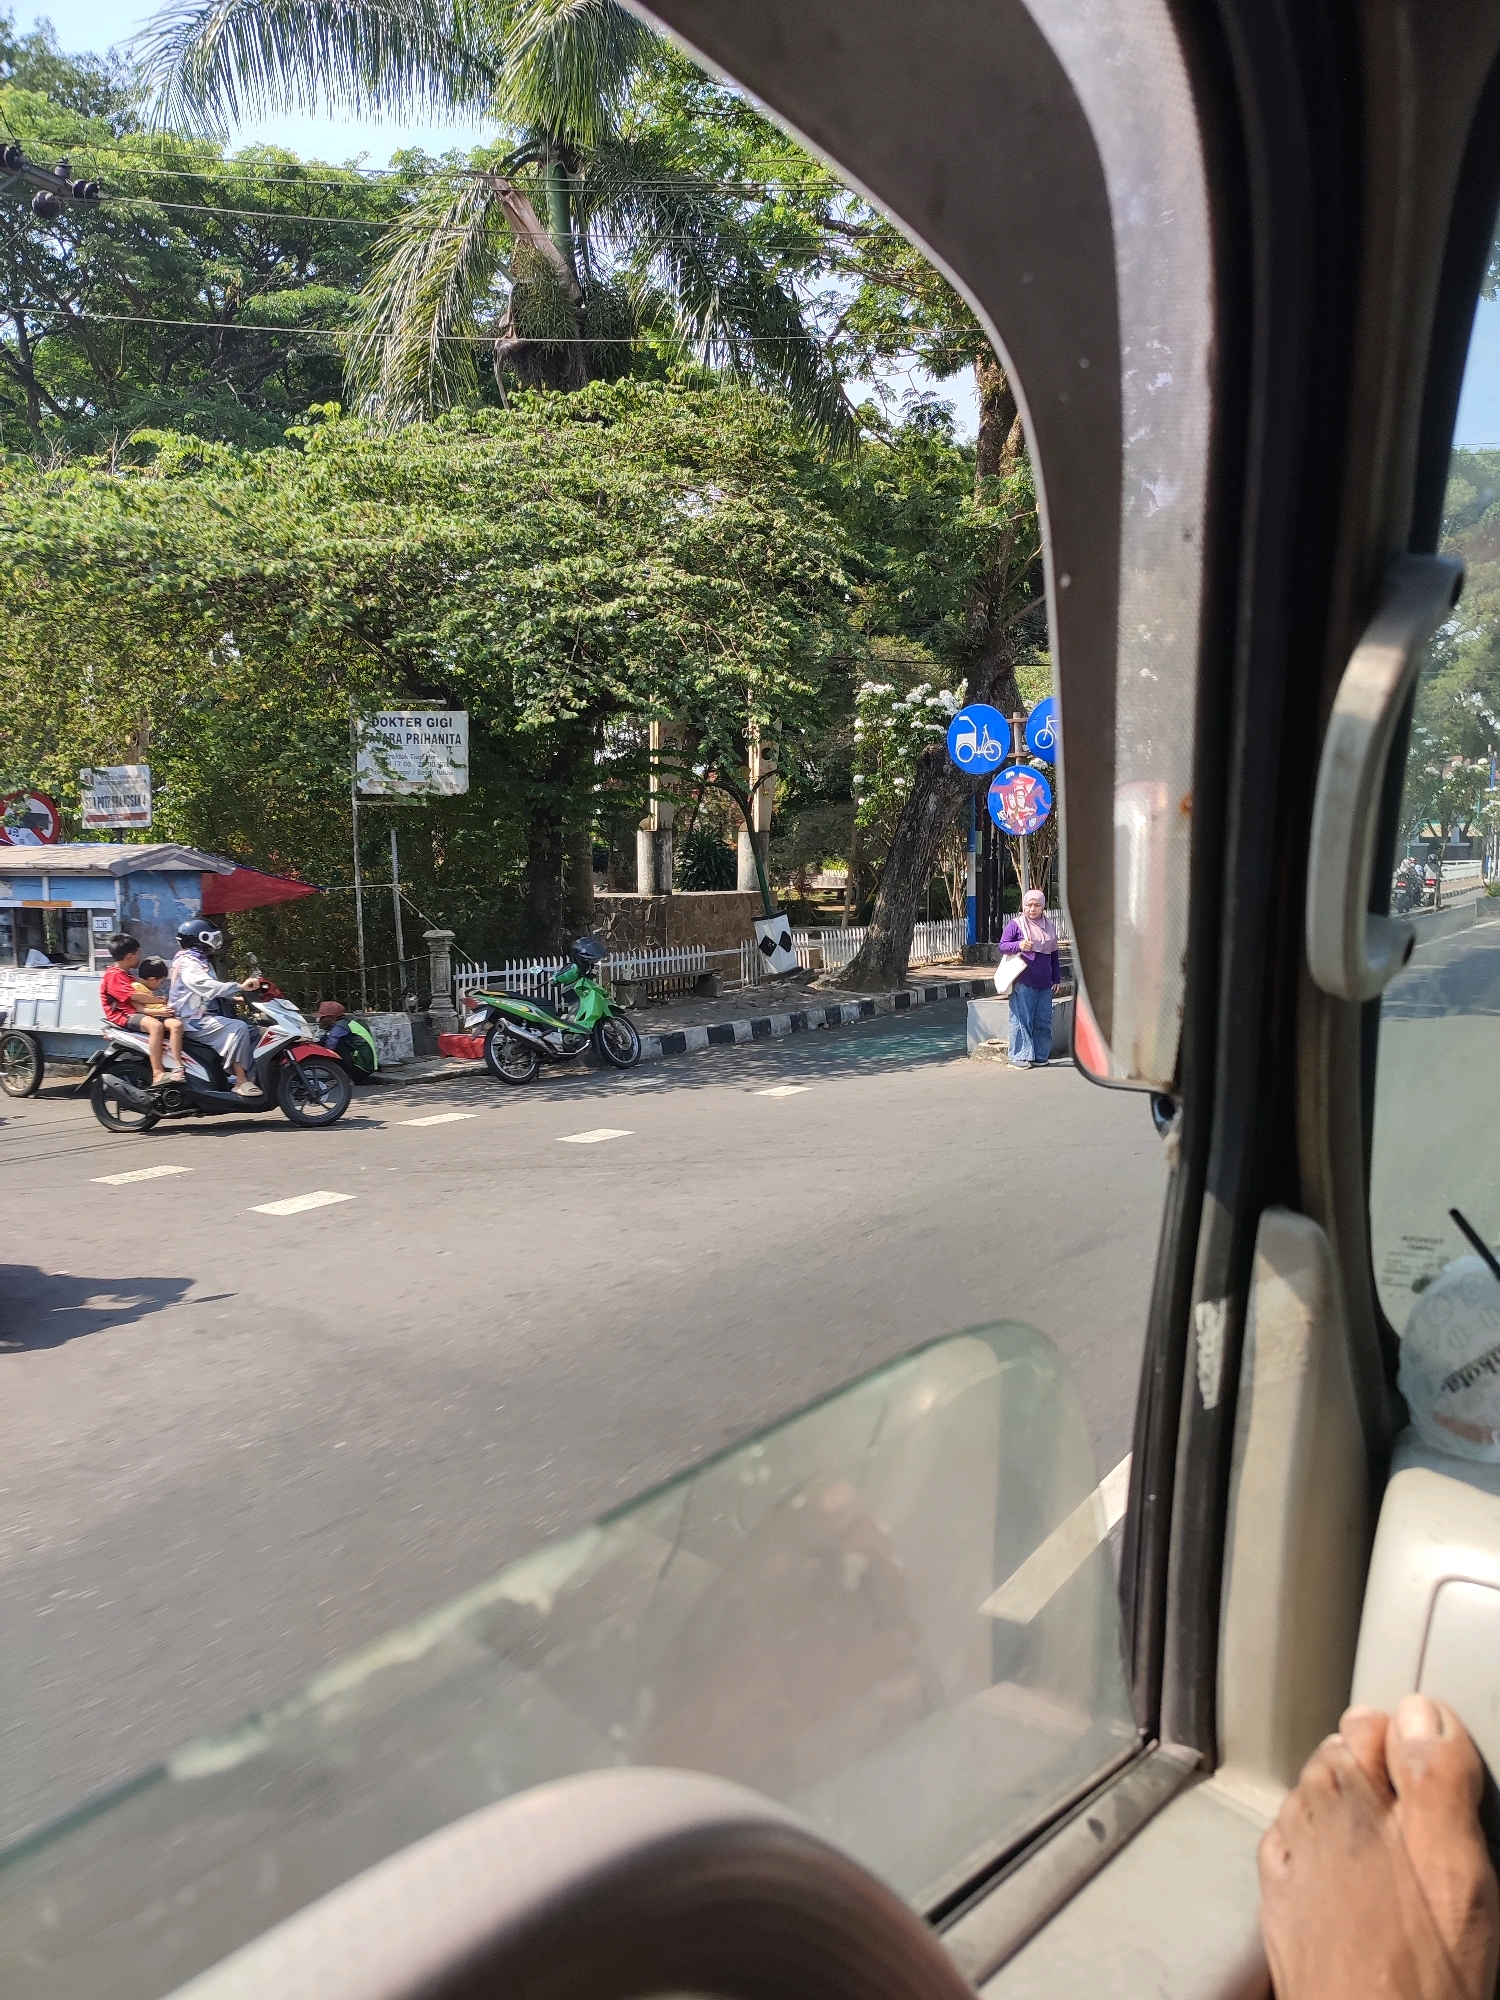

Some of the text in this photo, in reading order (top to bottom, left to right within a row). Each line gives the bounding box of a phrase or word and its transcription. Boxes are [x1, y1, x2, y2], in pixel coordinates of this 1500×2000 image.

[371, 716, 452, 728] DOKTER GIGI
[405, 733, 462, 745] PRIHANITA
